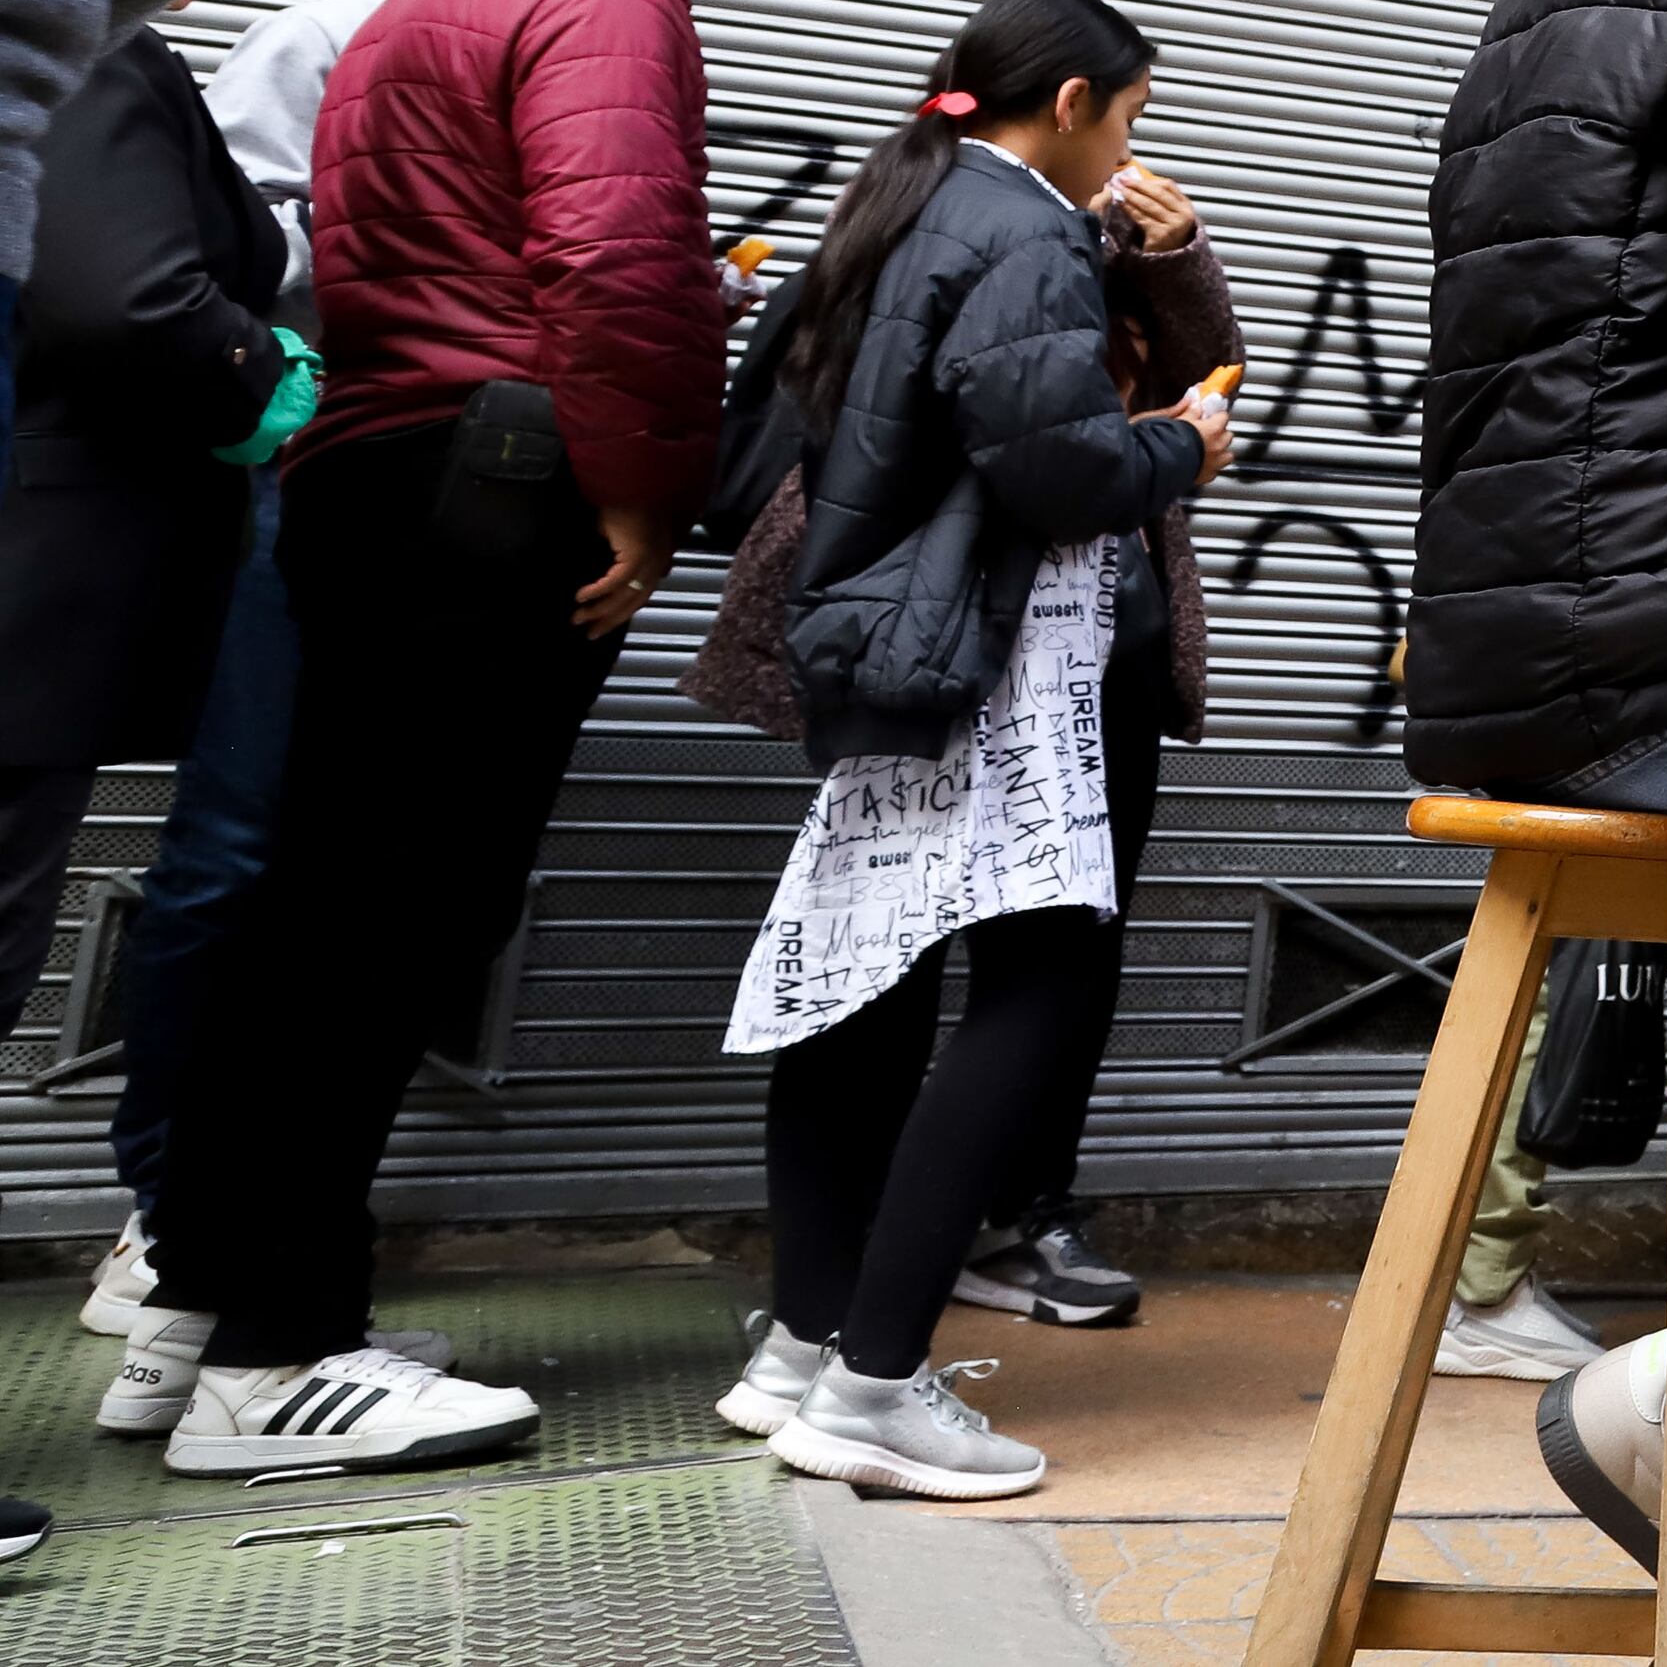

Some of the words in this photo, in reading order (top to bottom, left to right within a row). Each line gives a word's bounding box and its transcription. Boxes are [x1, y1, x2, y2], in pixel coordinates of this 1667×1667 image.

[1068, 681, 1102, 775] DREAM
[774, 921, 803, 1017] DREAM
[821, 906, 896, 964] Mood
